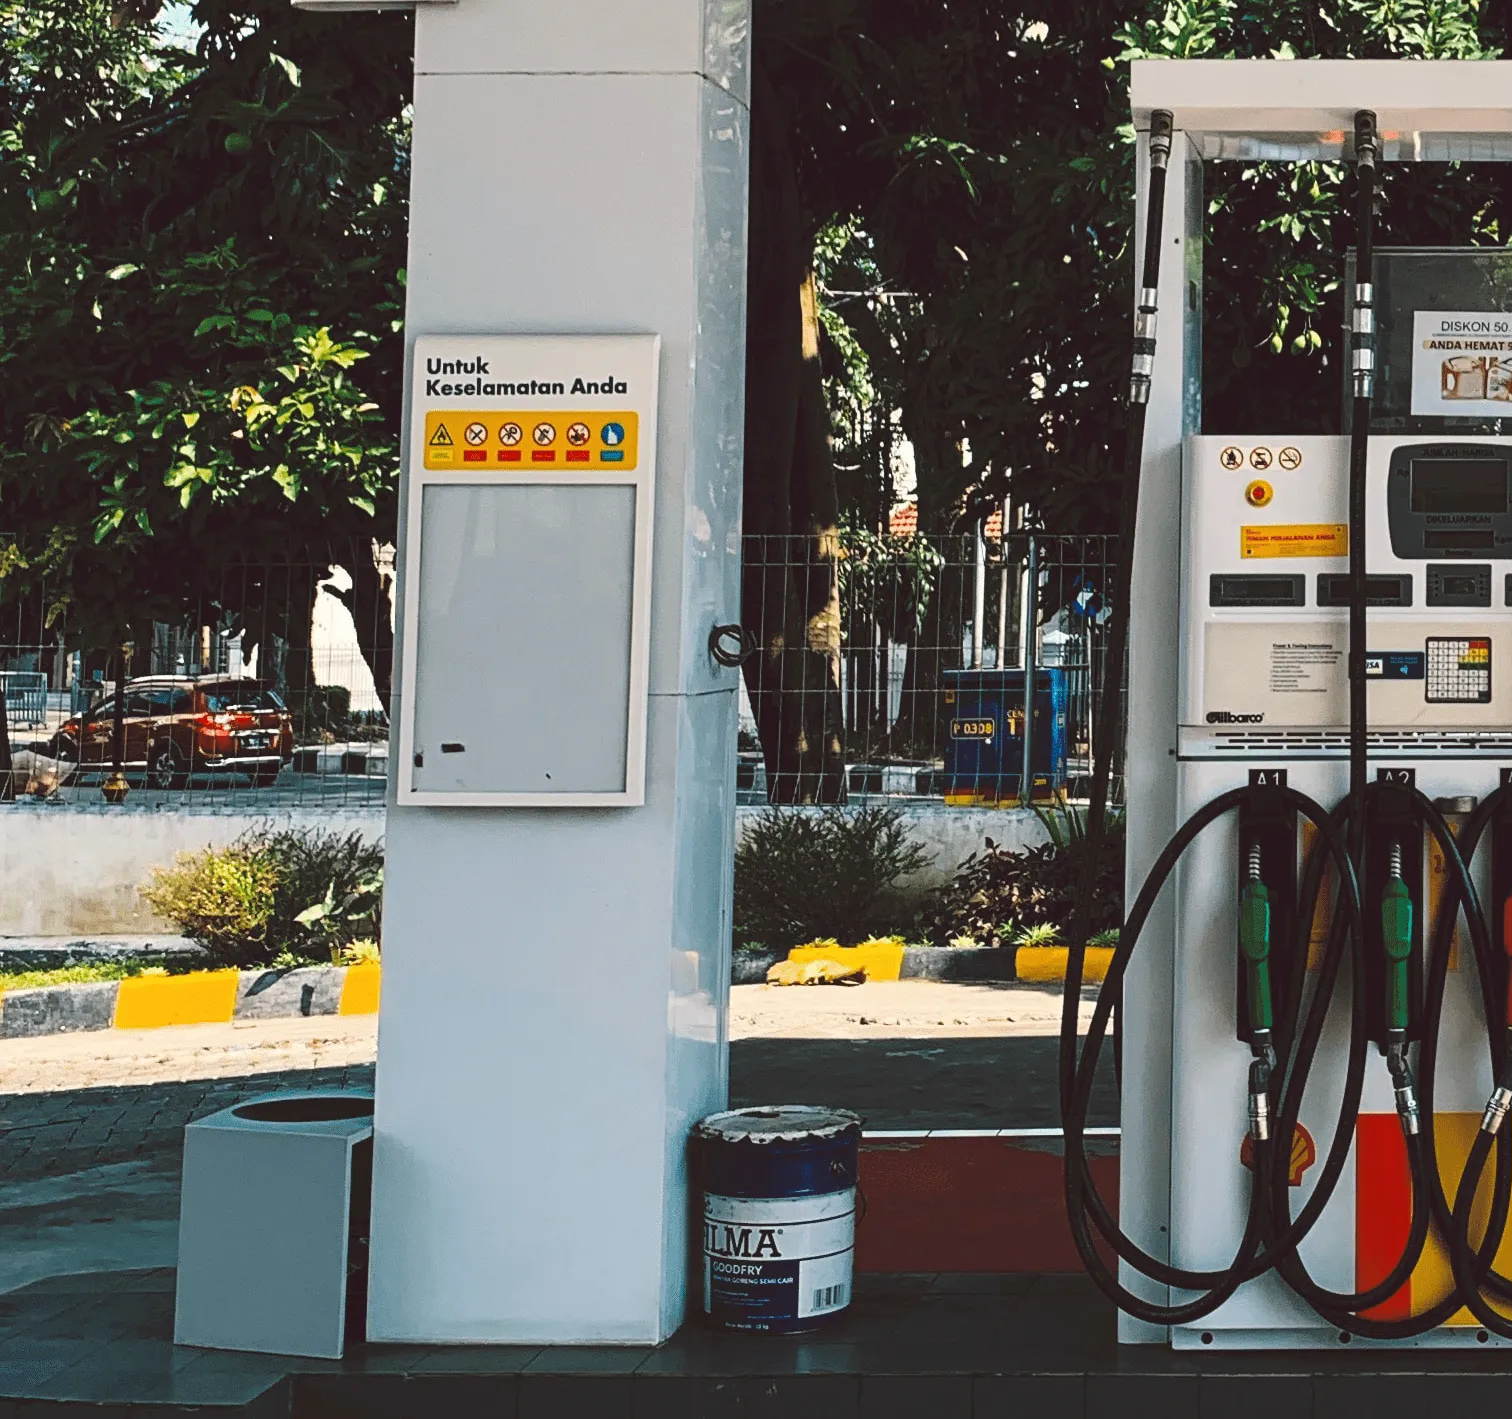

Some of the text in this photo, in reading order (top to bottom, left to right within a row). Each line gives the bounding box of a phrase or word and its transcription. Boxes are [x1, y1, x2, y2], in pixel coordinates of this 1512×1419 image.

[1441, 321, 1490, 332] DISKON
[1429, 341, 1462, 350] ANDA
[1465, 341, 1504, 350] HEMAT
[427, 356, 489, 374] Untuk
[426, 376, 628, 396] Keselamatan Anda
[1426, 516, 1491, 524] DIKELUARKAN
[1206, 712, 1262, 723] Gilbarco
[963, 723, 992, 734] 0308
[713, 1262, 763, 1275] GOODFRY
